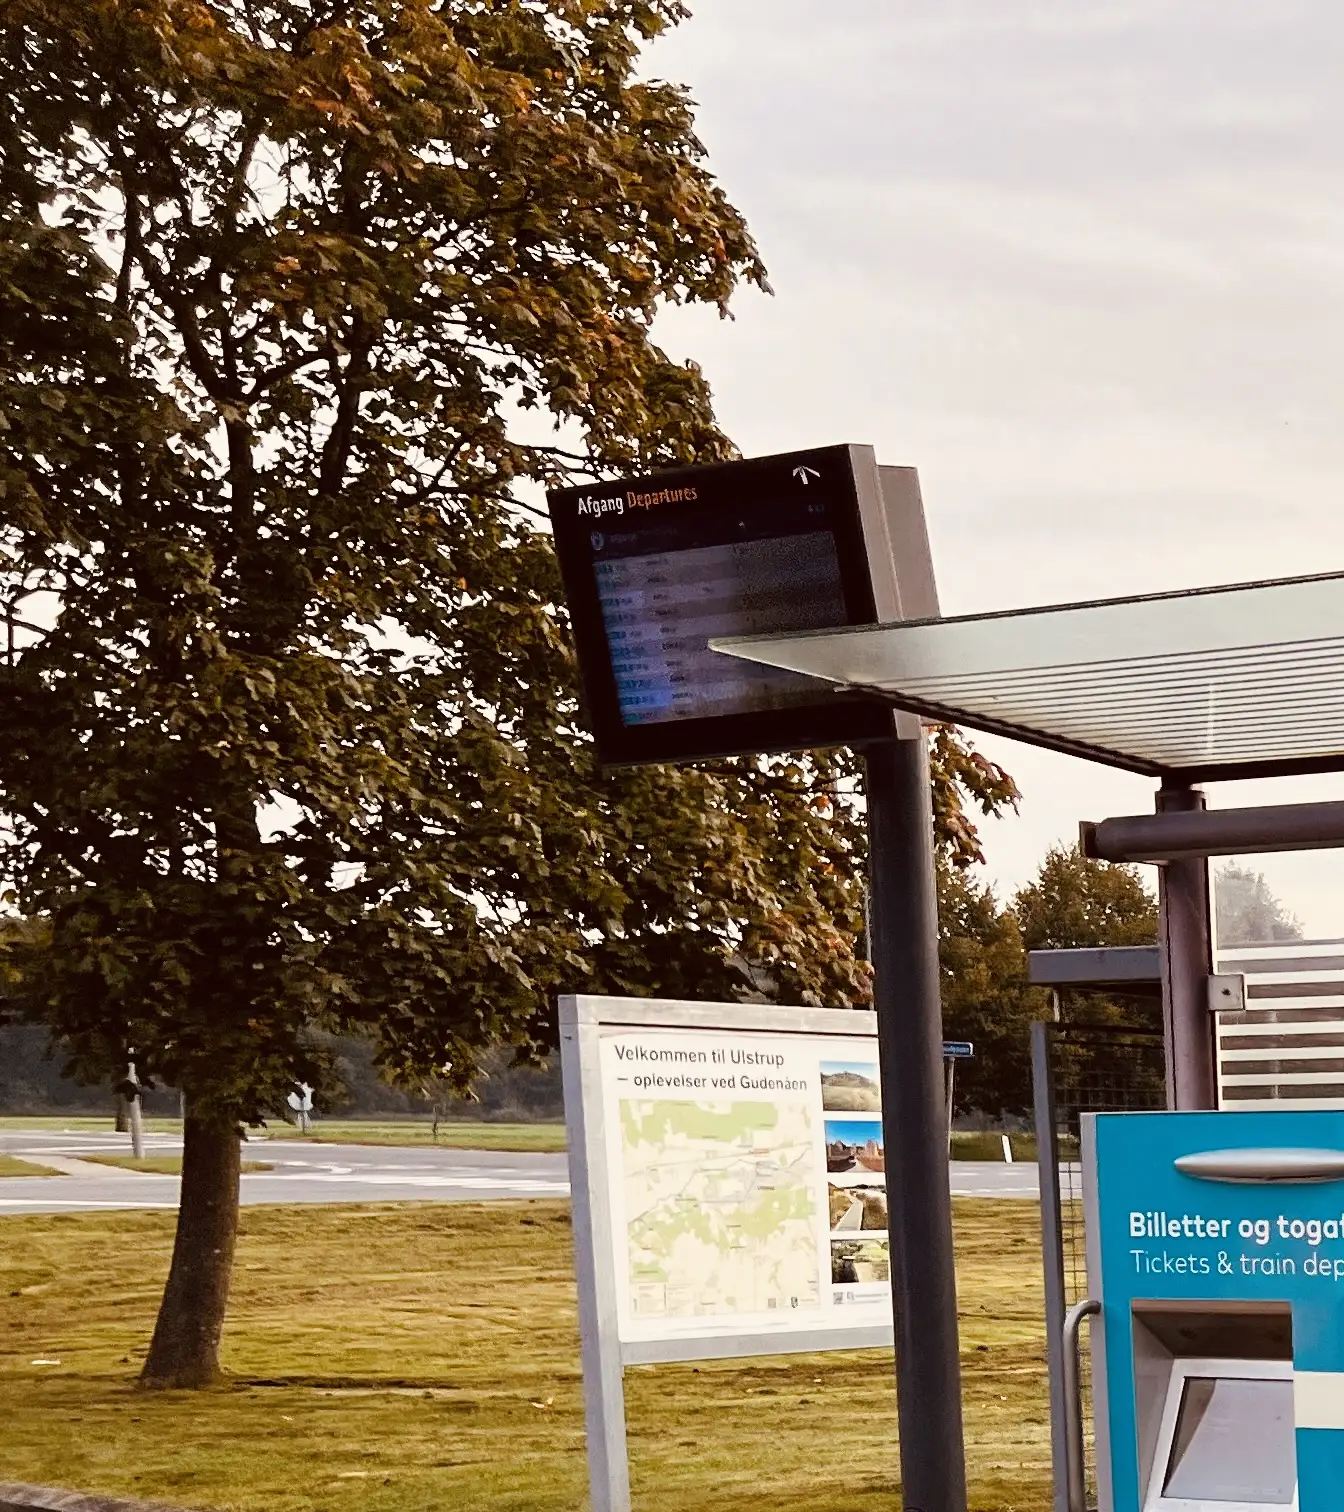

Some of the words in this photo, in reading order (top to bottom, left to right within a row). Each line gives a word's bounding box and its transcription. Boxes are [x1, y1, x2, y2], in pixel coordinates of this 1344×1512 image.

[577, 495, 624, 518] Afgang
[626, 487, 698, 511] Departures
[614, 1044, 706, 1063] Velkommen
[711, 1048, 725, 1064] til
[730, 1049, 785, 1068] Ulstrup
[633, 1072, 708, 1090] oplevelser
[711, 1075, 736, 1089] ved
[740, 1075, 807, 1091] Gudenåen
[1129, 1211, 1231, 1239] Billetter
[1237, 1219, 1270, 1245] og
[1129, 1249, 1210, 1274] Tickets
[1217, 1250, 1234, 1275] &
[1240, 1252, 1296, 1275] train
